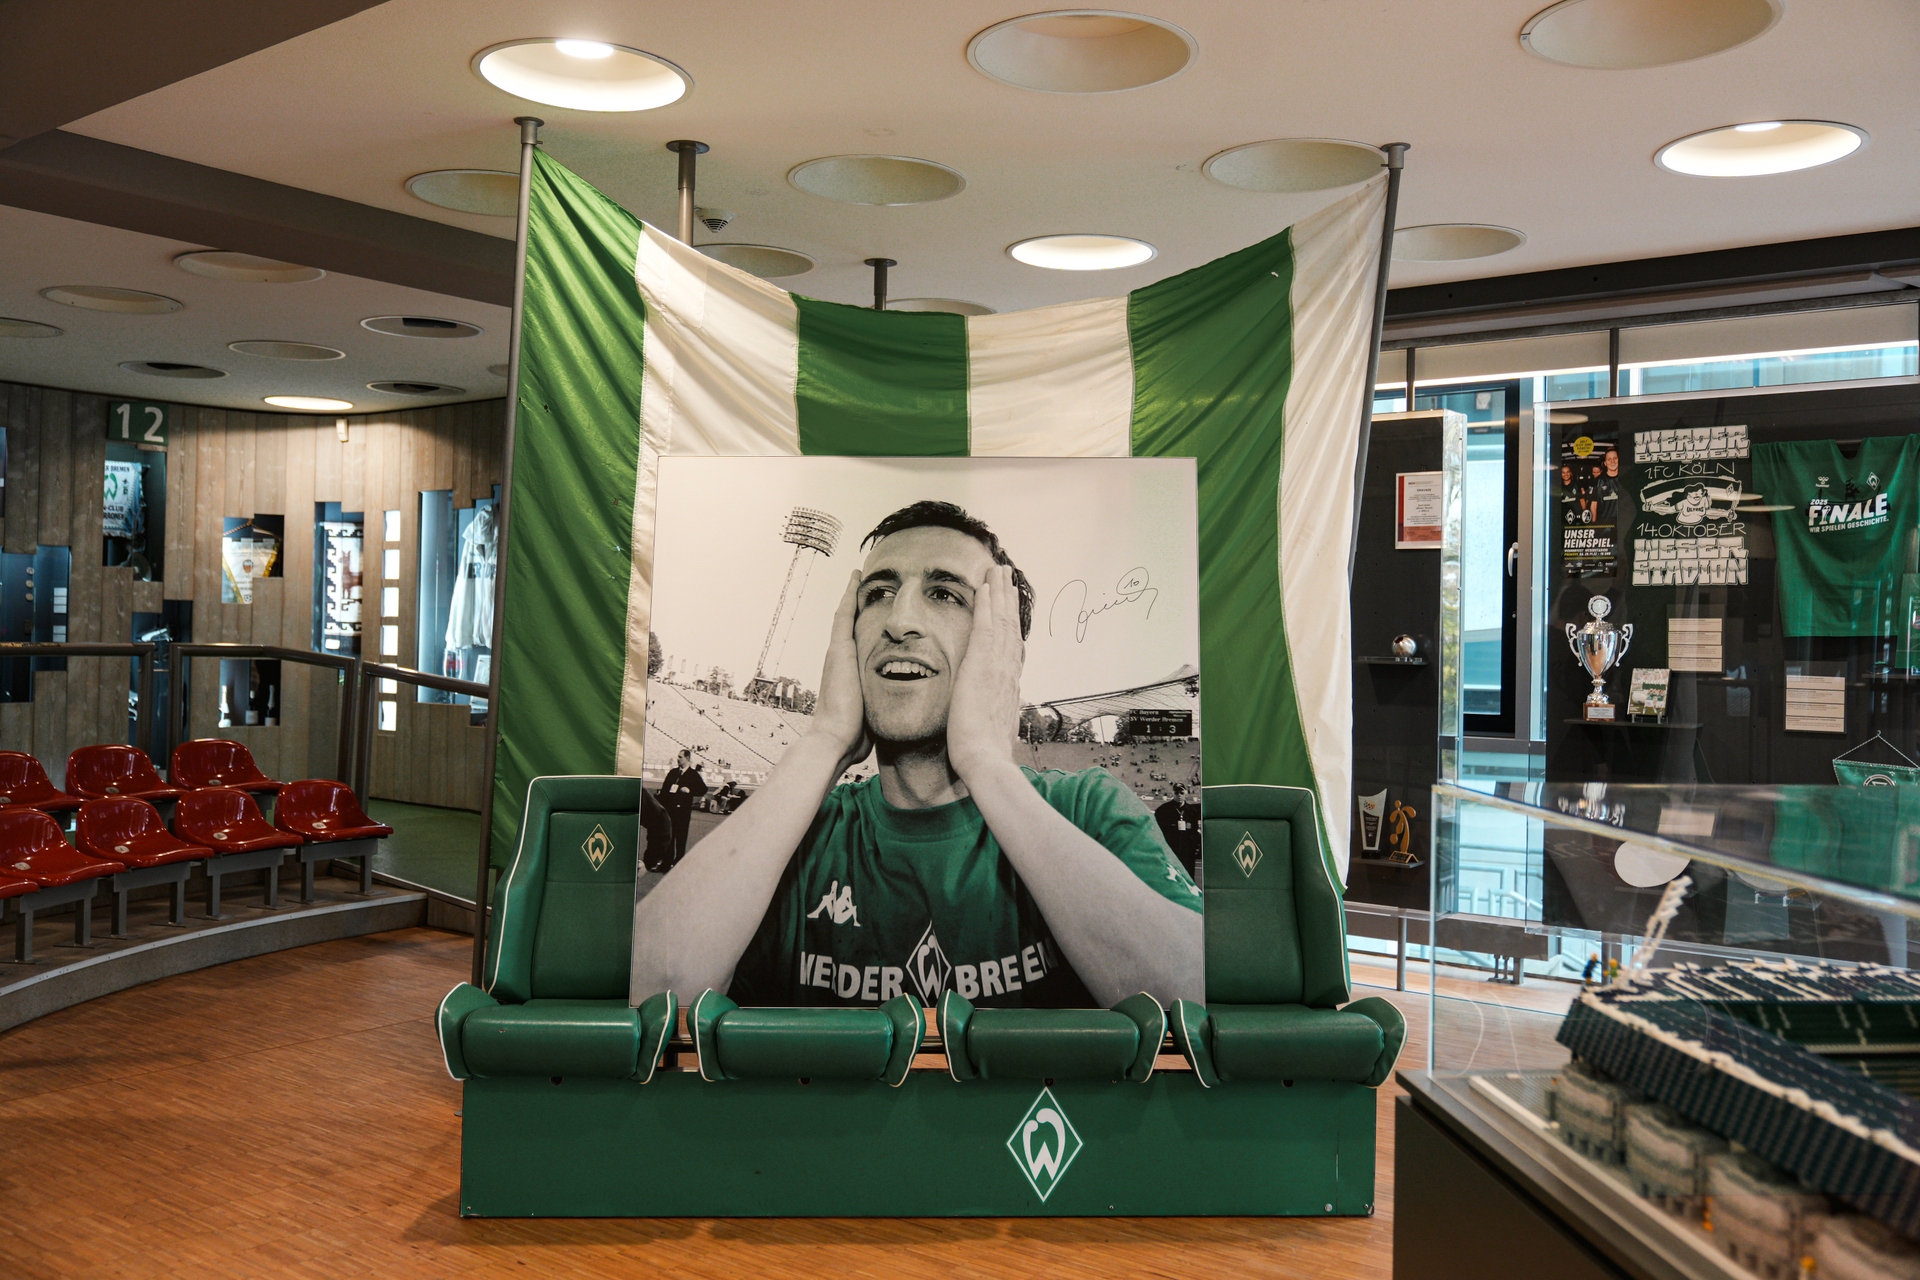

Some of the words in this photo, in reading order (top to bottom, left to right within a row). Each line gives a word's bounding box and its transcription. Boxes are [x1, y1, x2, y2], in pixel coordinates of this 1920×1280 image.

[116, 403, 164, 443] 12
[1634, 425, 1750, 454] WERDER
[1635, 447, 1749, 464] BREMEN
[1679, 462, 1735, 476] KÖLN
[1808, 493, 1888, 526] FINALE
[1821, 523, 1846, 533] SPIELEN
[1847, 516, 1889, 529] GESCHICHTE.
[1564, 529, 1595, 539] UNSER
[1564, 538, 1614, 549] HEIMSPIEL.
[1634, 537, 1749, 562] WESER
[1632, 558, 1749, 586] STADION
[1146, 725, 1151, 733] 1
[1169, 725, 1176, 734] 3
